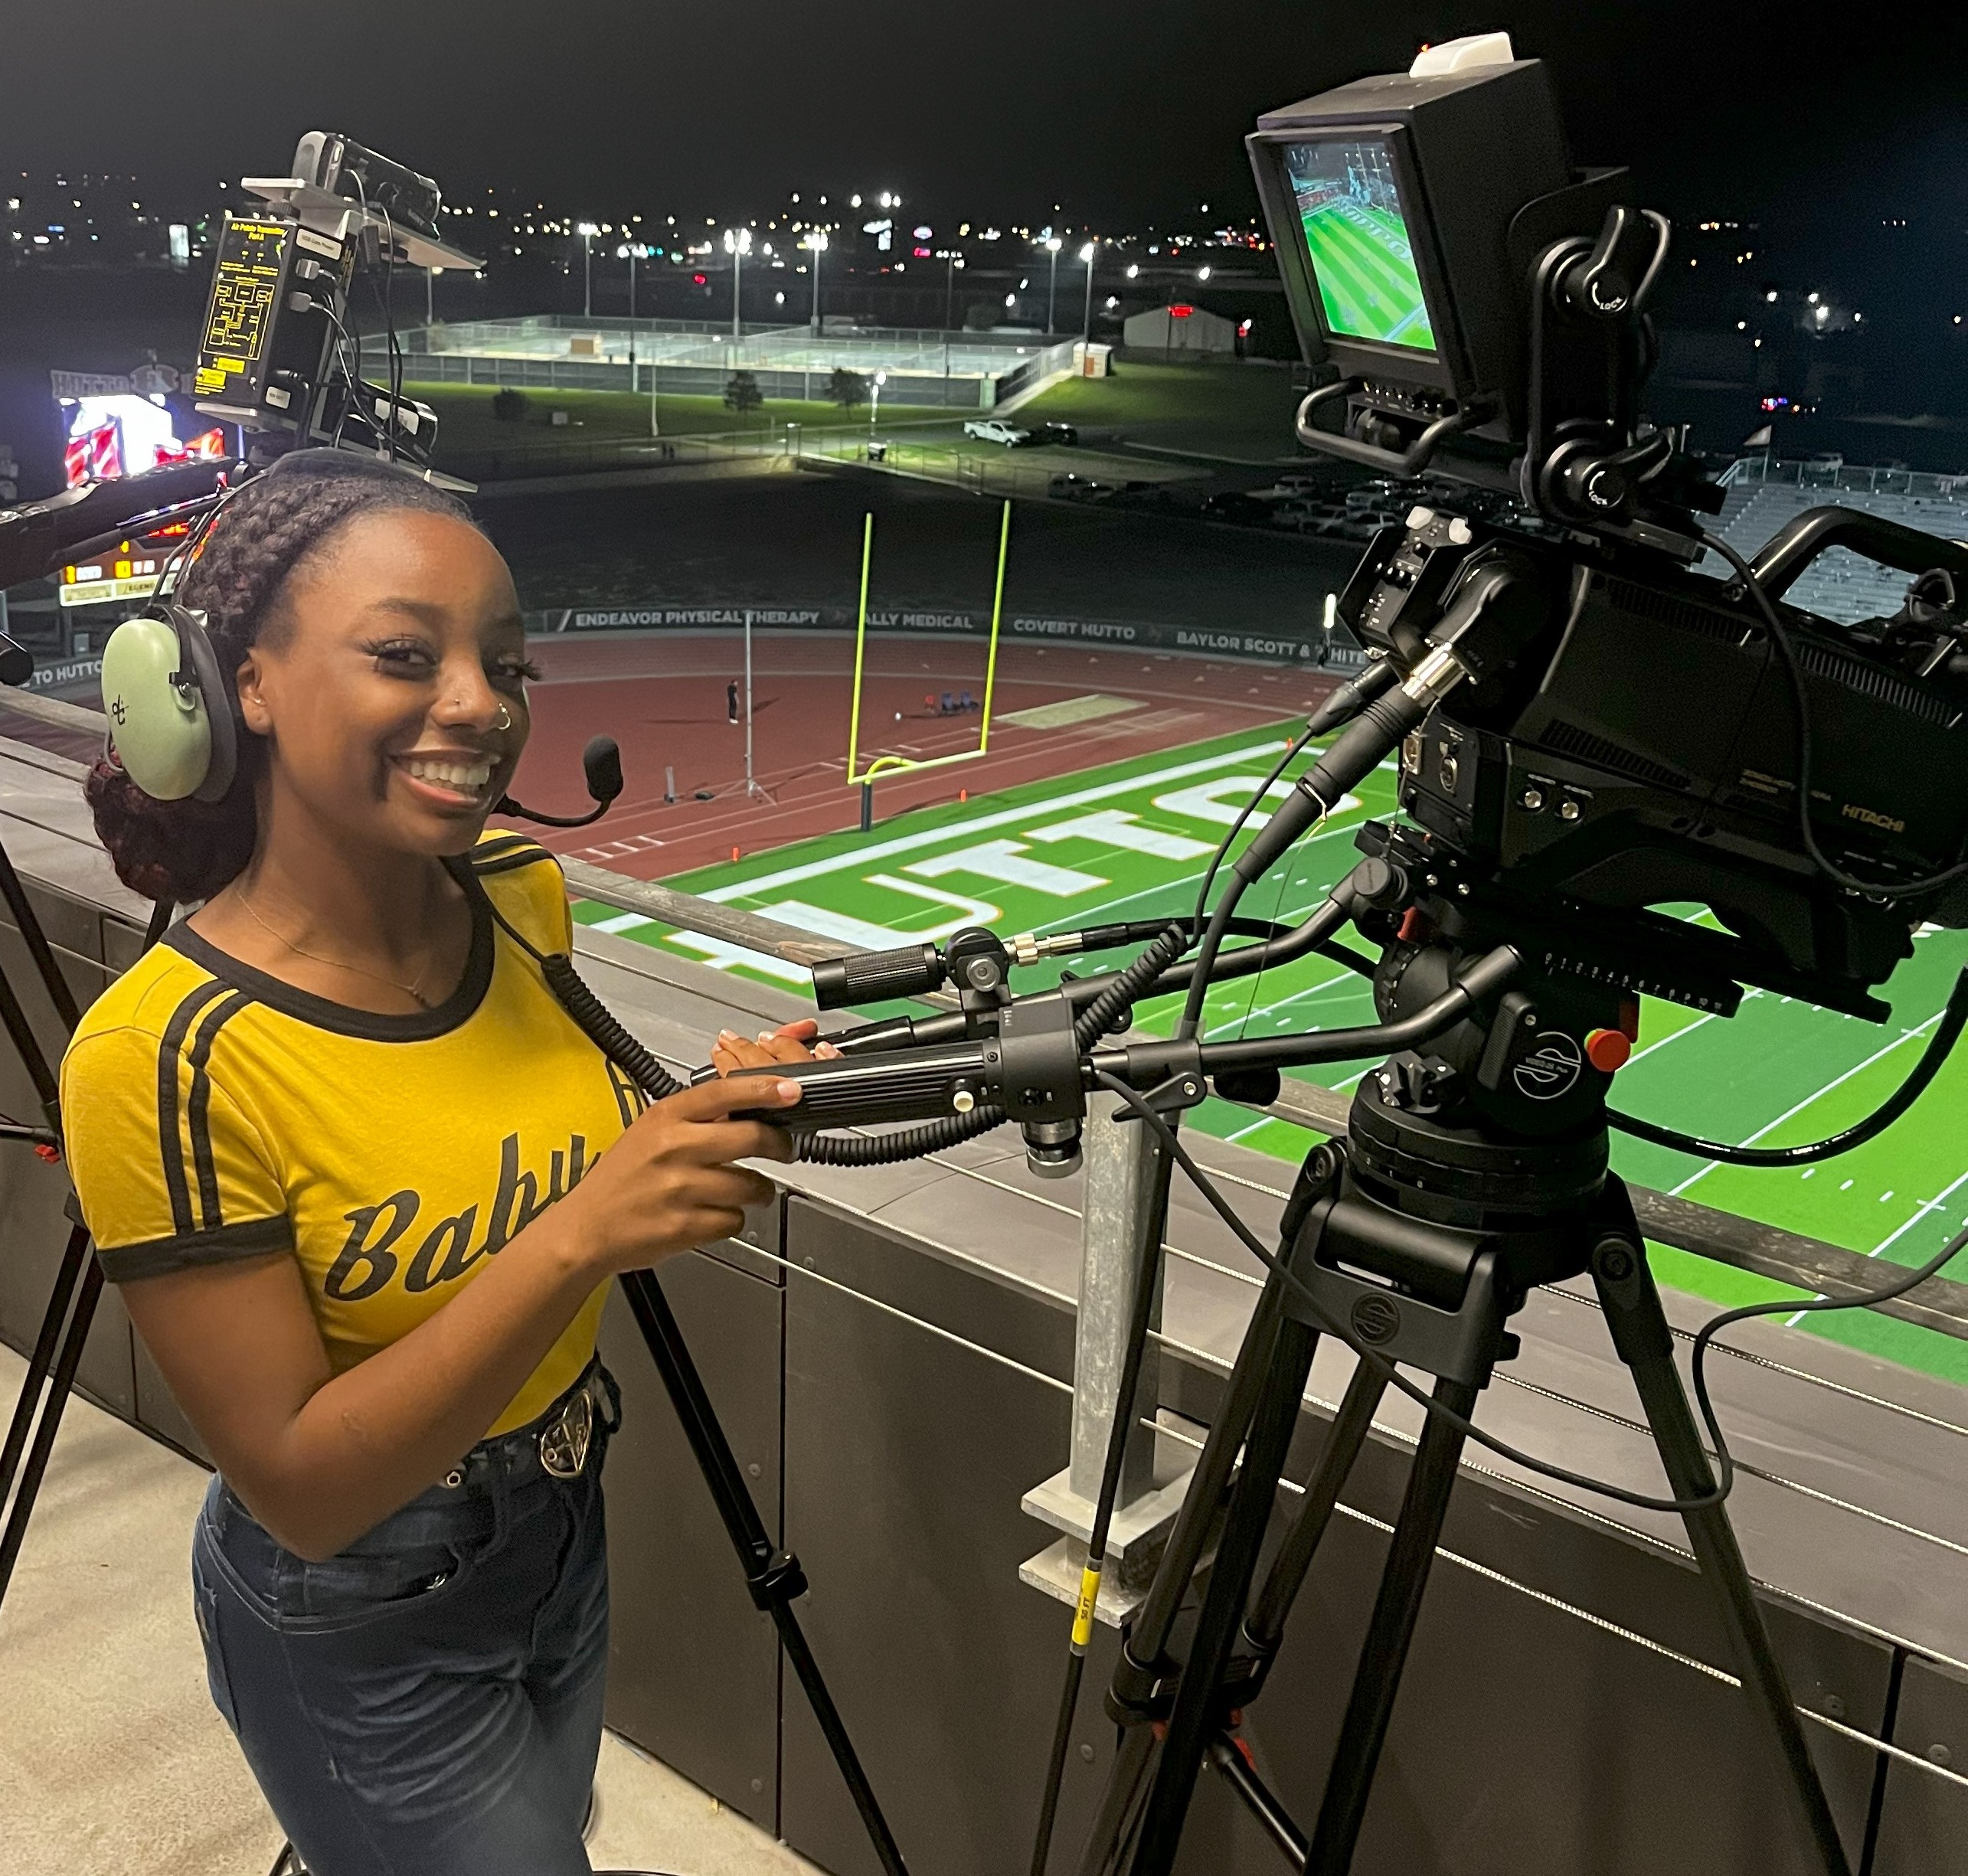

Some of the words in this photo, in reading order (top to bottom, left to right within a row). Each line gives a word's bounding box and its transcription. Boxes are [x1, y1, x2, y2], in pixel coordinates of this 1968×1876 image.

[1599, 296, 1623, 310] LOCK
[576, 612, 663, 627] ENDEAVOR
[665, 610, 742, 624] PHYSICAL
[742, 610, 820, 624] THERAPY
[903, 614, 973, 628] MEDICAL
[1014, 619, 1078, 634] COVERT
[1081, 623, 1136, 640] HUTTO
[1177, 631, 1240, 649] BAYLOR
[1244, 638, 1296, 655] SCOTT
[1299, 644, 1310, 658] &
[33, 669, 53, 685] TO
[1842, 804, 1905, 833] HITACHI
[1083, 1597, 1090, 1608] FT
